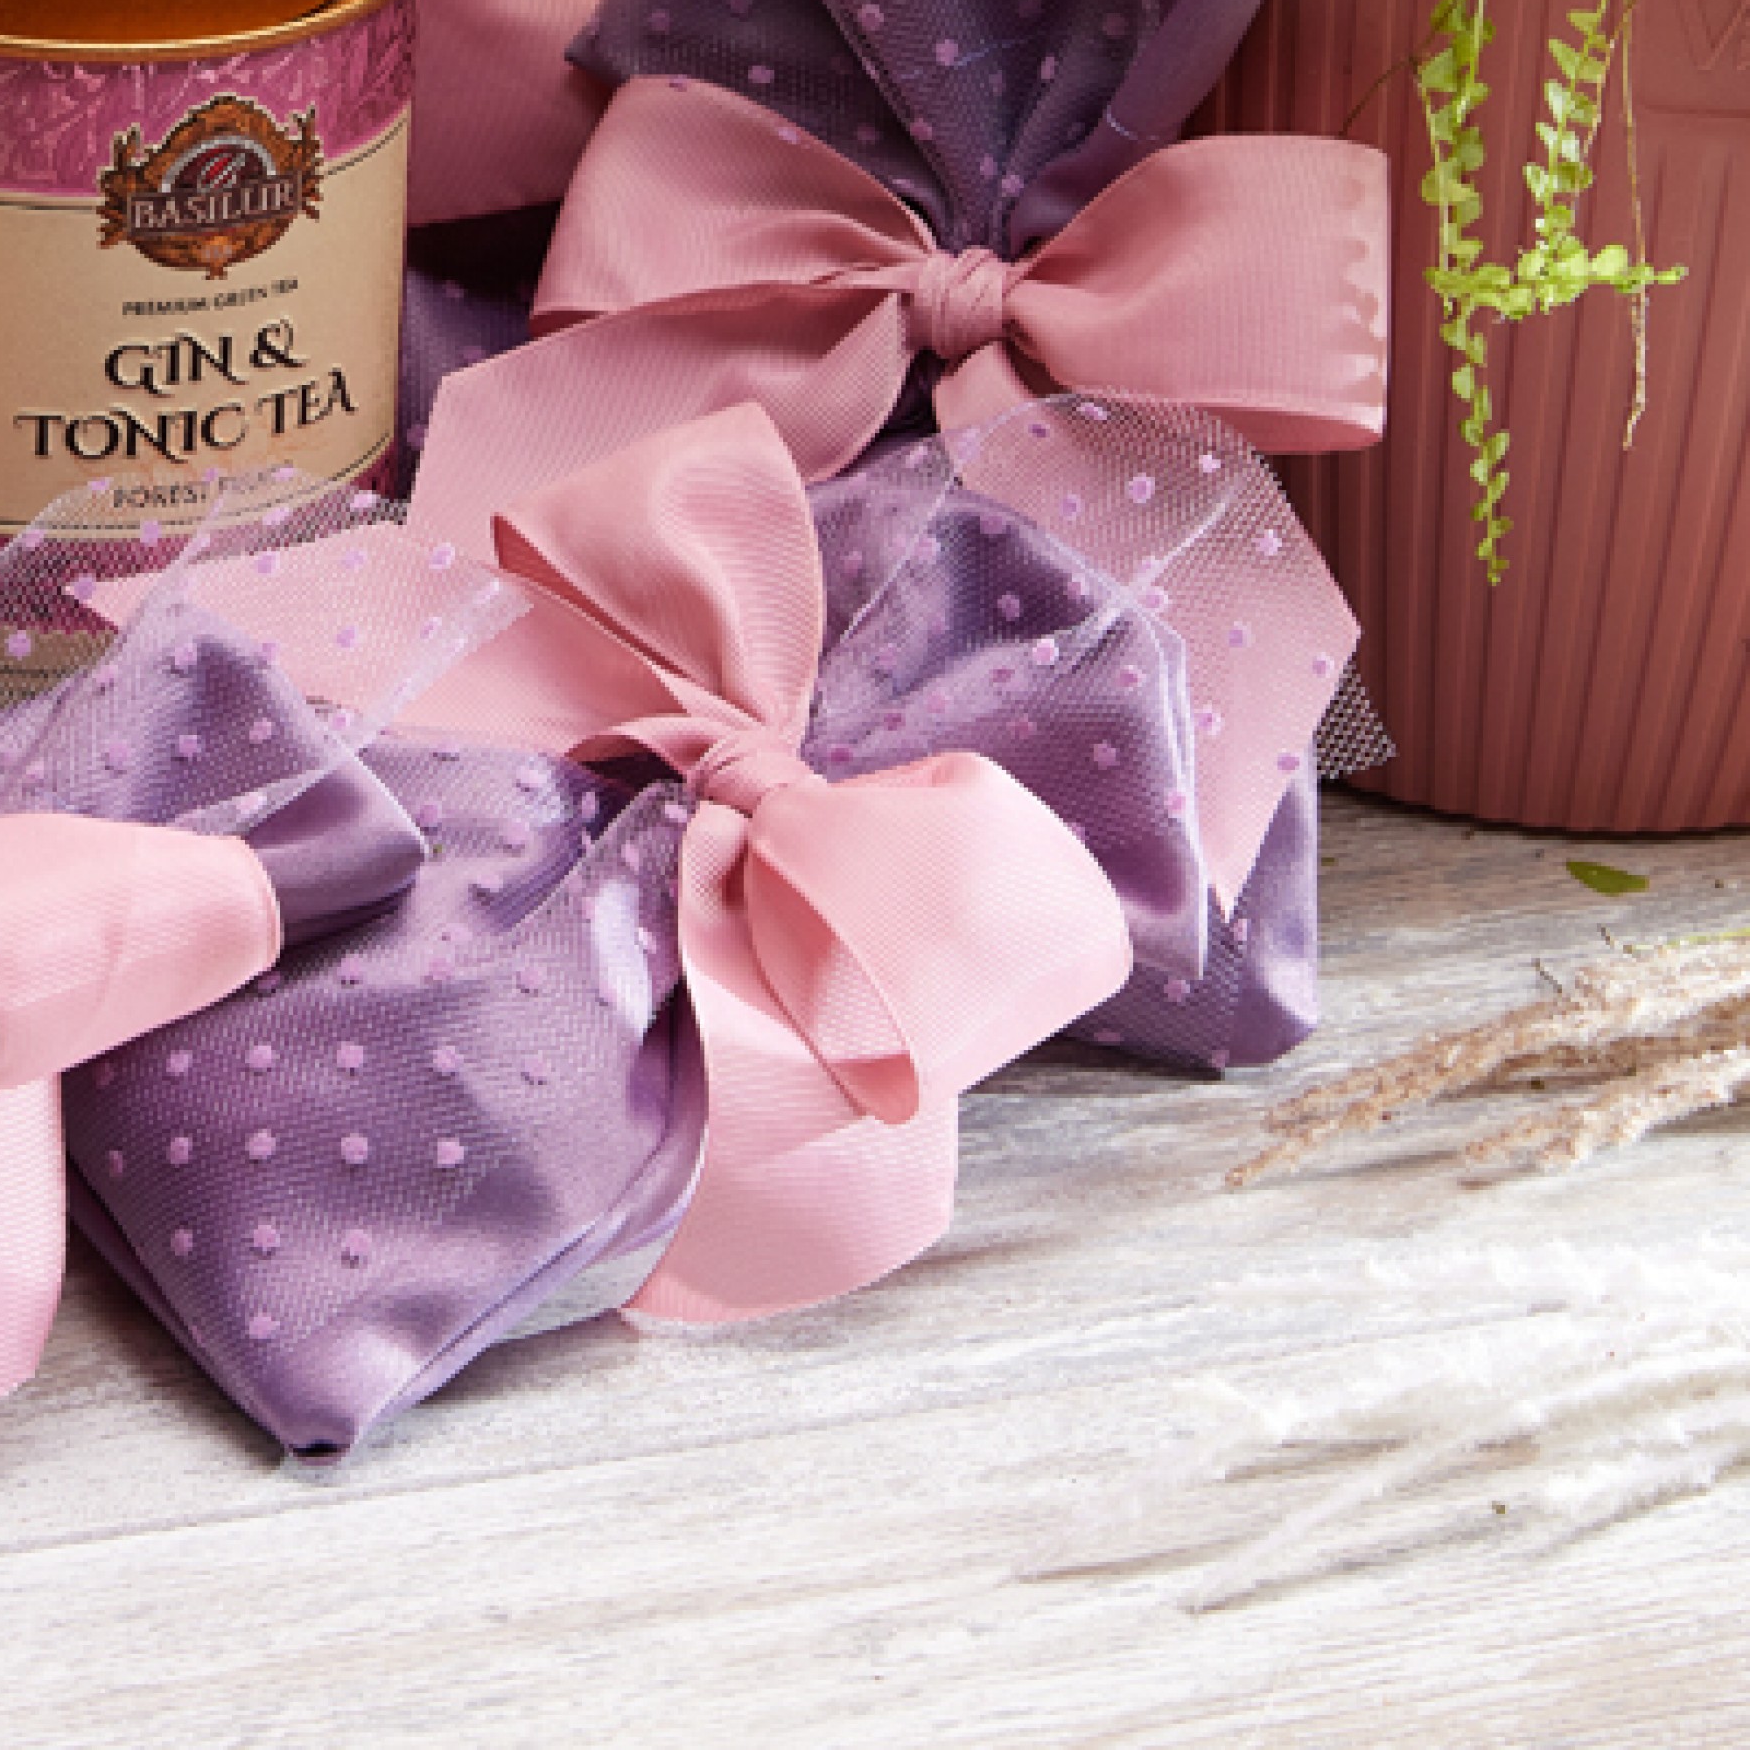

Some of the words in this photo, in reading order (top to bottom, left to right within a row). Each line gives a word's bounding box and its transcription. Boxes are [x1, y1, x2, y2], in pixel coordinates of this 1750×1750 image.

[132, 181, 295, 229] BASILUR
[105, 330, 248, 397] GIN
[250, 317, 309, 368] &
[14, 402, 248, 463] TONIC
[255, 365, 357, 434] TEA
